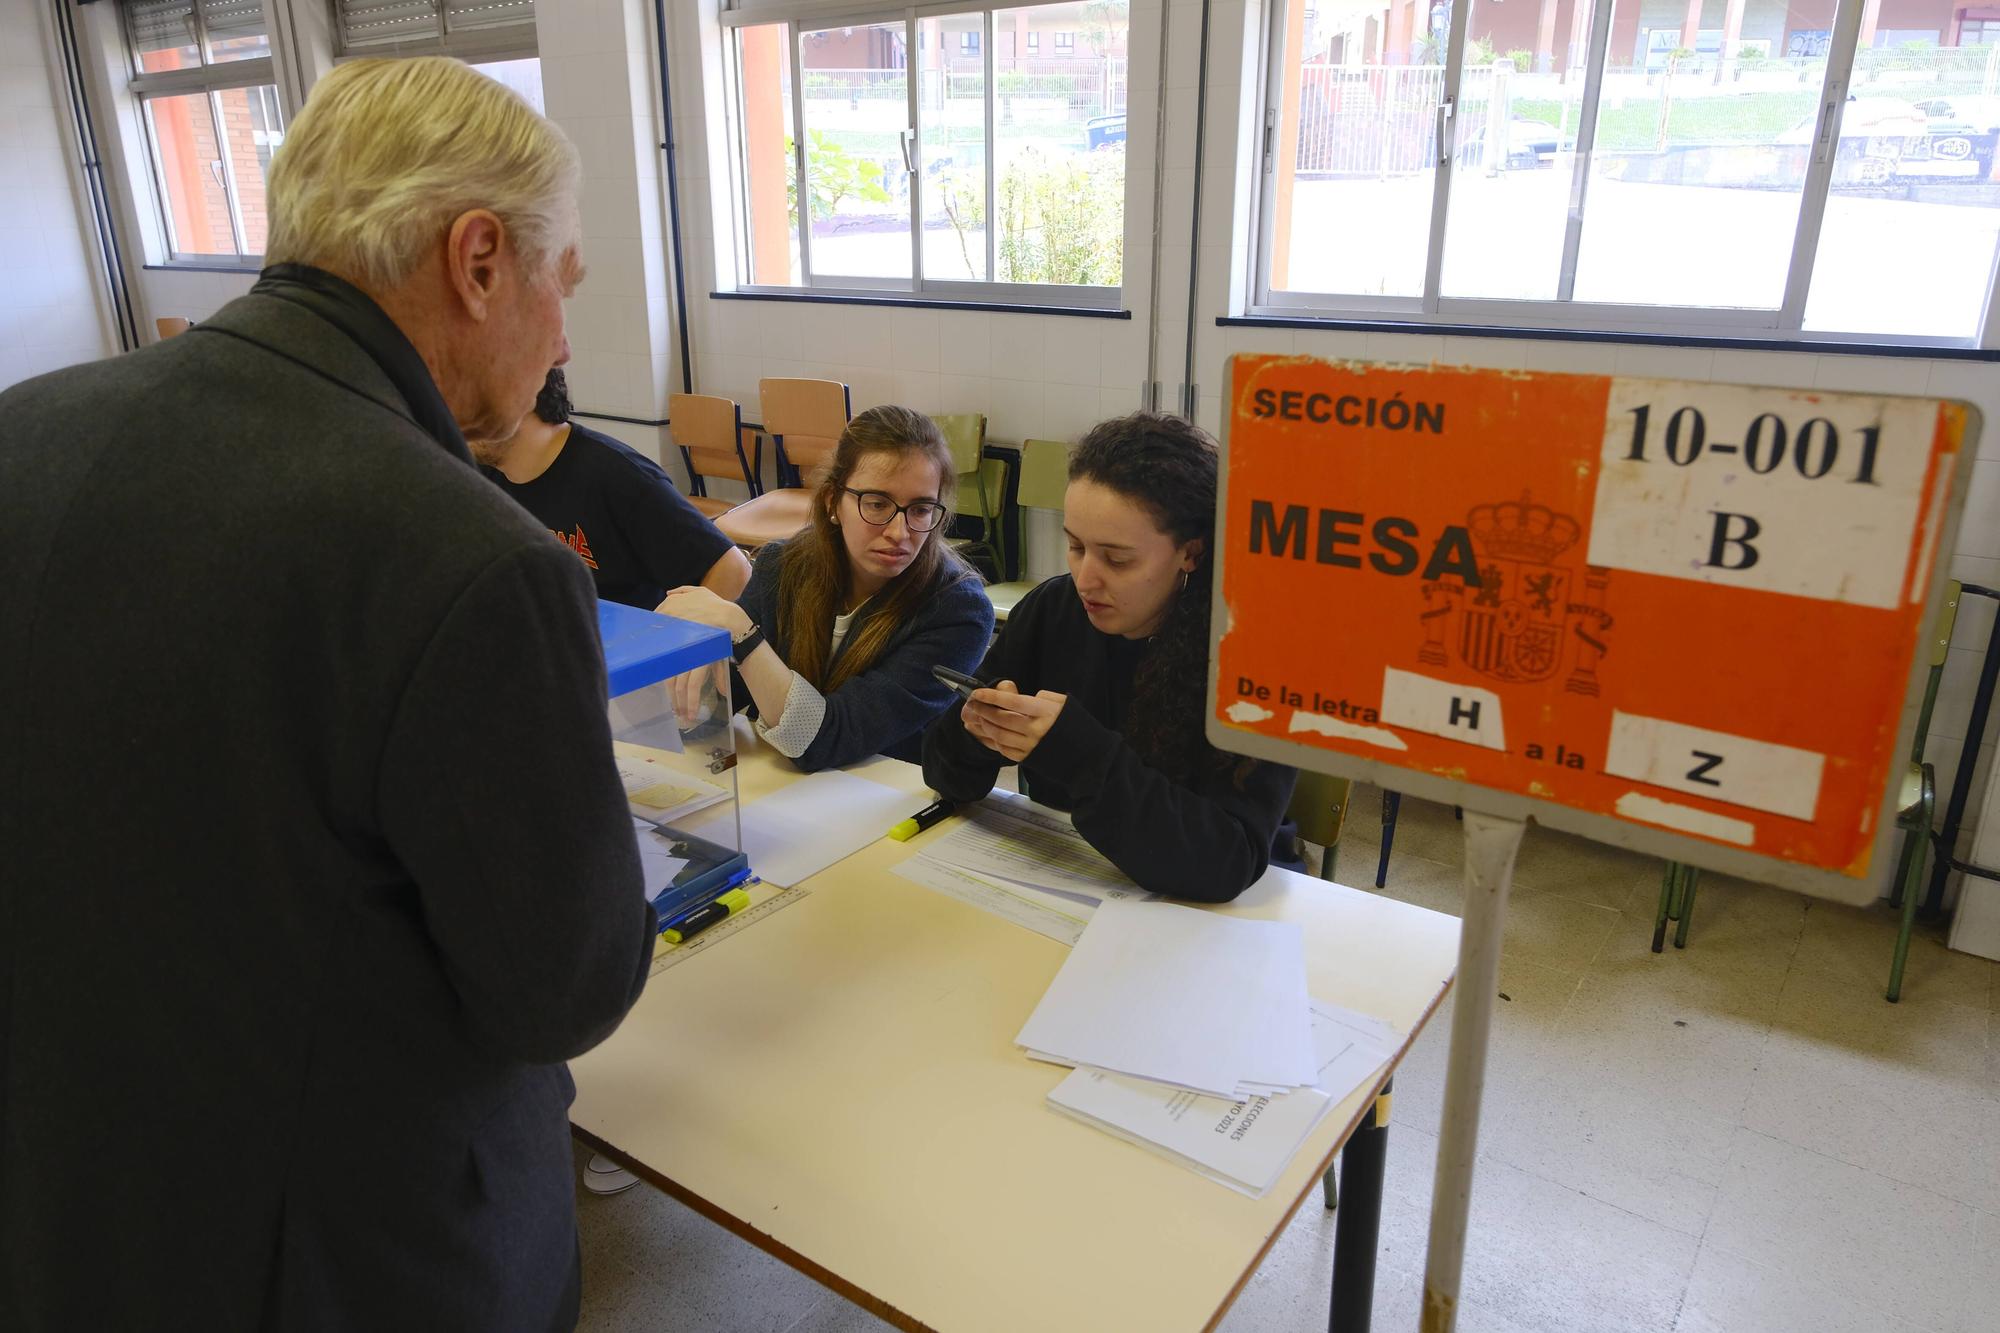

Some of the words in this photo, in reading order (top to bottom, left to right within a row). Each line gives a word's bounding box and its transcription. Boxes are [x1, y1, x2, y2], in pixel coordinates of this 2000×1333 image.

[1252, 388, 1445, 434] SECCIÓN
[1620, 403, 1882, 487] 10-001
[1248, 499, 1484, 588] MESA
[1700, 509, 1762, 571] B
[1236, 676, 1271, 701] De
[1279, 685, 1304, 709] la
[1312, 692, 1381, 724] letra
[1448, 696, 1482, 731] H
[1524, 742, 1545, 761] a
[1555, 745, 1586, 770] la
[1684, 749, 1726, 787] Z
[1214, 1114, 1236, 1135] 2023
[1229, 1096, 1270, 1142] ELECCIONES
